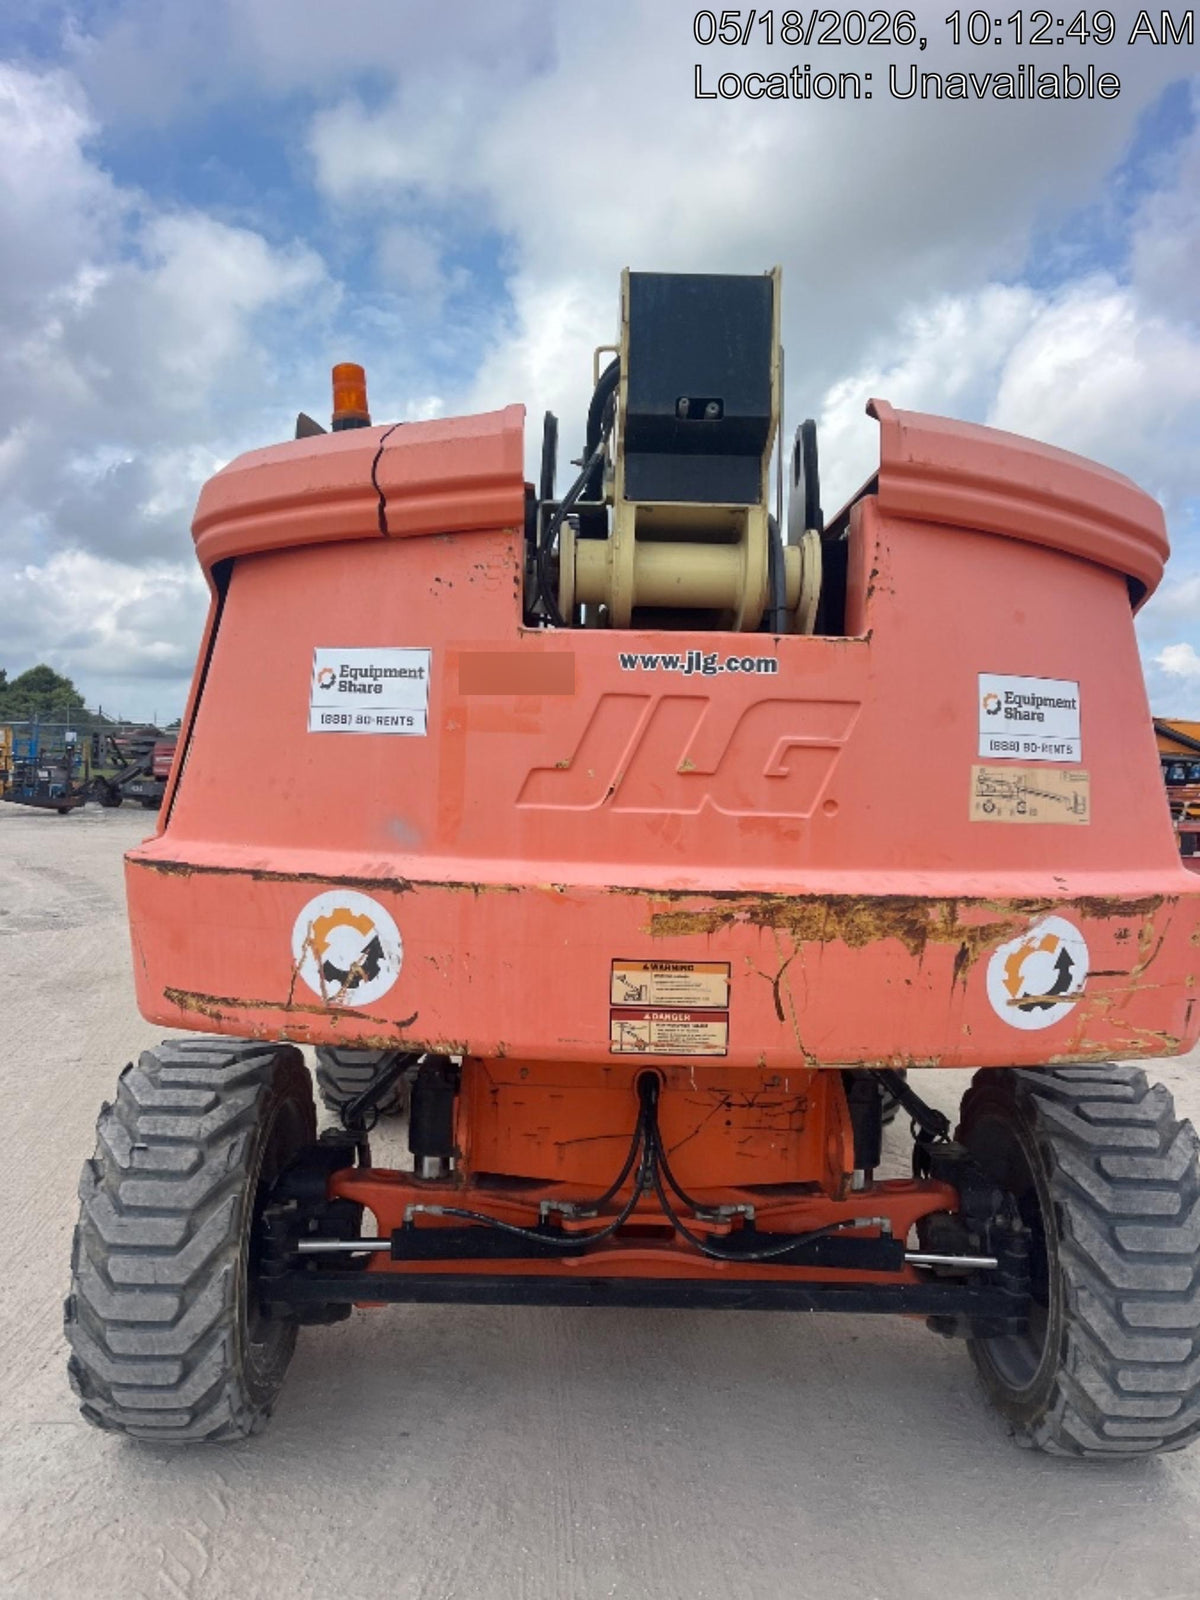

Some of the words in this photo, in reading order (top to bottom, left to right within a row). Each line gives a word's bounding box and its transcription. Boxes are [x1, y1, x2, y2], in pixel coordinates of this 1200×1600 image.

[619, 651, 778, 674] www.jlg.com
[339, 664, 425, 681] Equipment
[338, 680, 383, 694] Share
[1004, 691, 1077, 710] Equipment
[1004, 707, 1045, 722] Share
[650, 963, 694, 971] WARNING
[652, 1012, 691, 1021] DANGER
